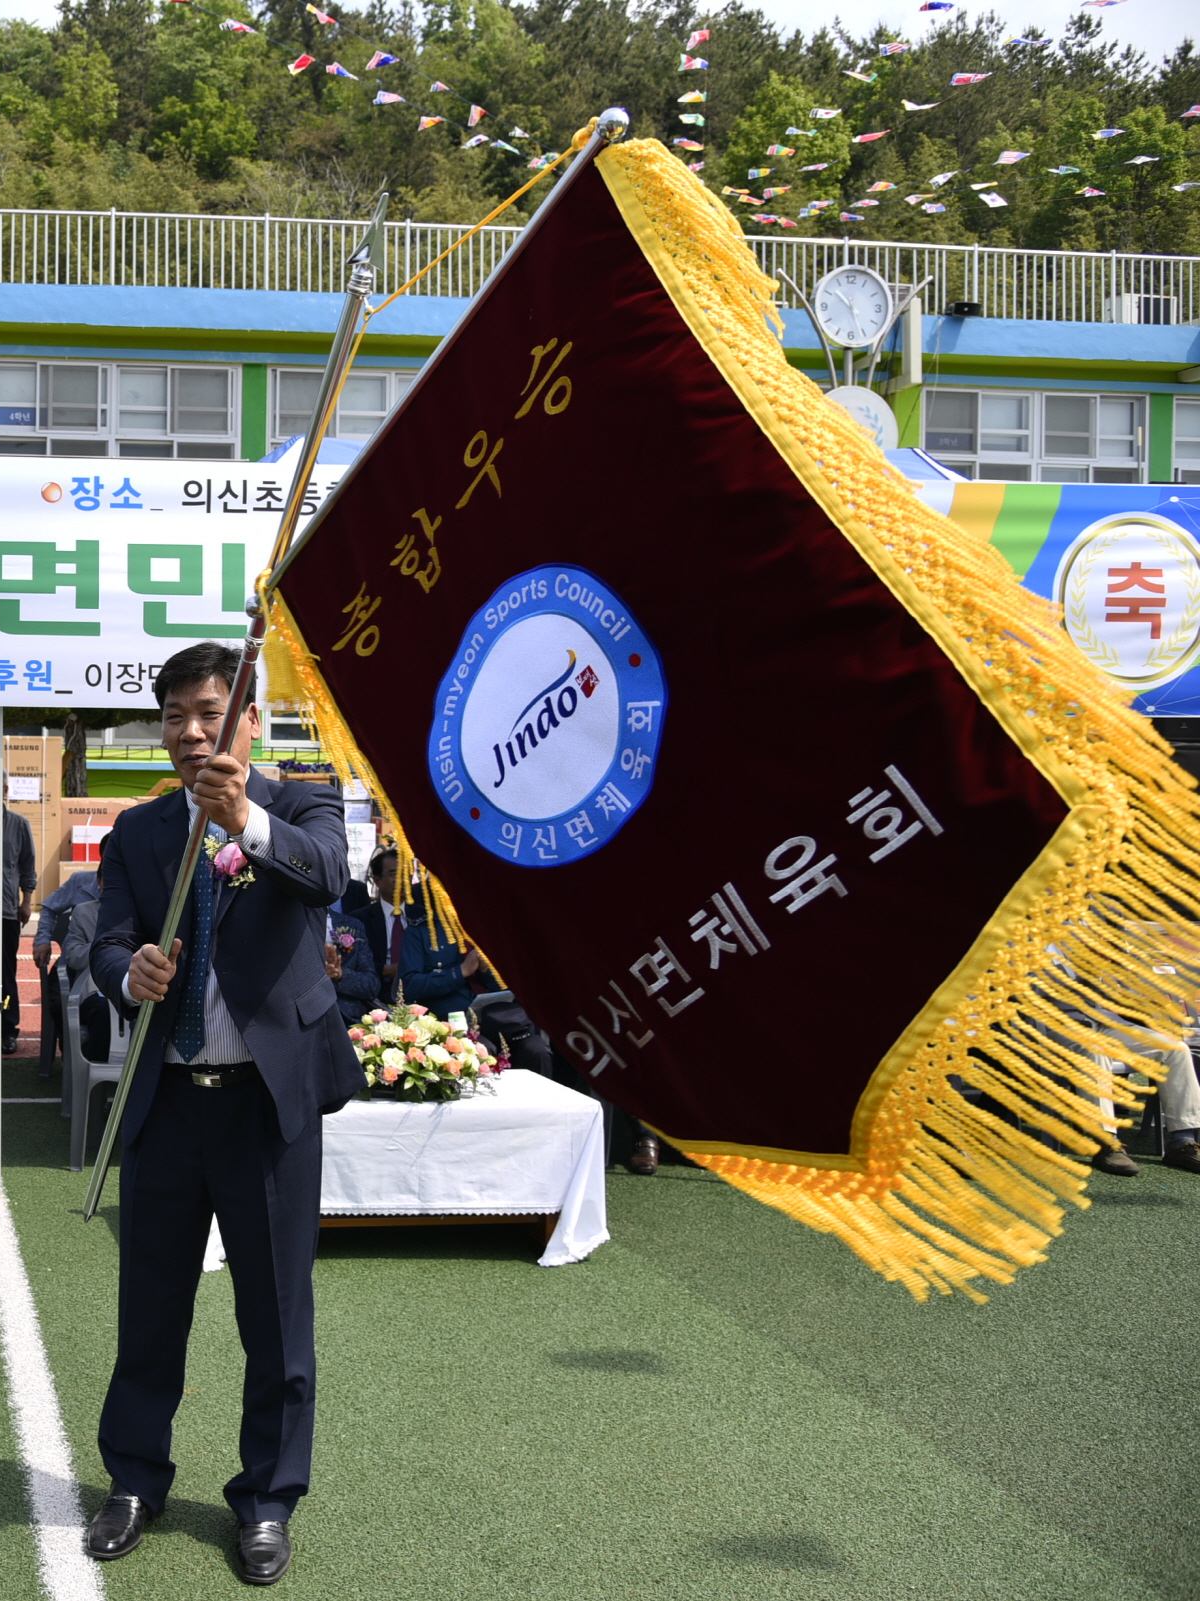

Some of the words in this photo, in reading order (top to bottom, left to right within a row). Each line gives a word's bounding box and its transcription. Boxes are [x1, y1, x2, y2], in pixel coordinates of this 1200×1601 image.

[845, 275, 857, 285] 12
[820, 302, 829, 312] 9
[874, 304, 882, 313] 3
[847, 331, 855, 340] 6
[182, 478, 341, 516] 의신초등
[1104, 561, 1167, 640] 축
[435, 631, 485, 803] Uisin-myeon
[484, 577, 549, 630] Sports
[554, 573, 632, 642] Council
[492, 685, 578, 788] Jindo
[497, 700, 660, 859] 의신면체육회
[68, 807, 108, 815] SAMSUNG
[565, 763, 944, 1078] 의신면체육회
